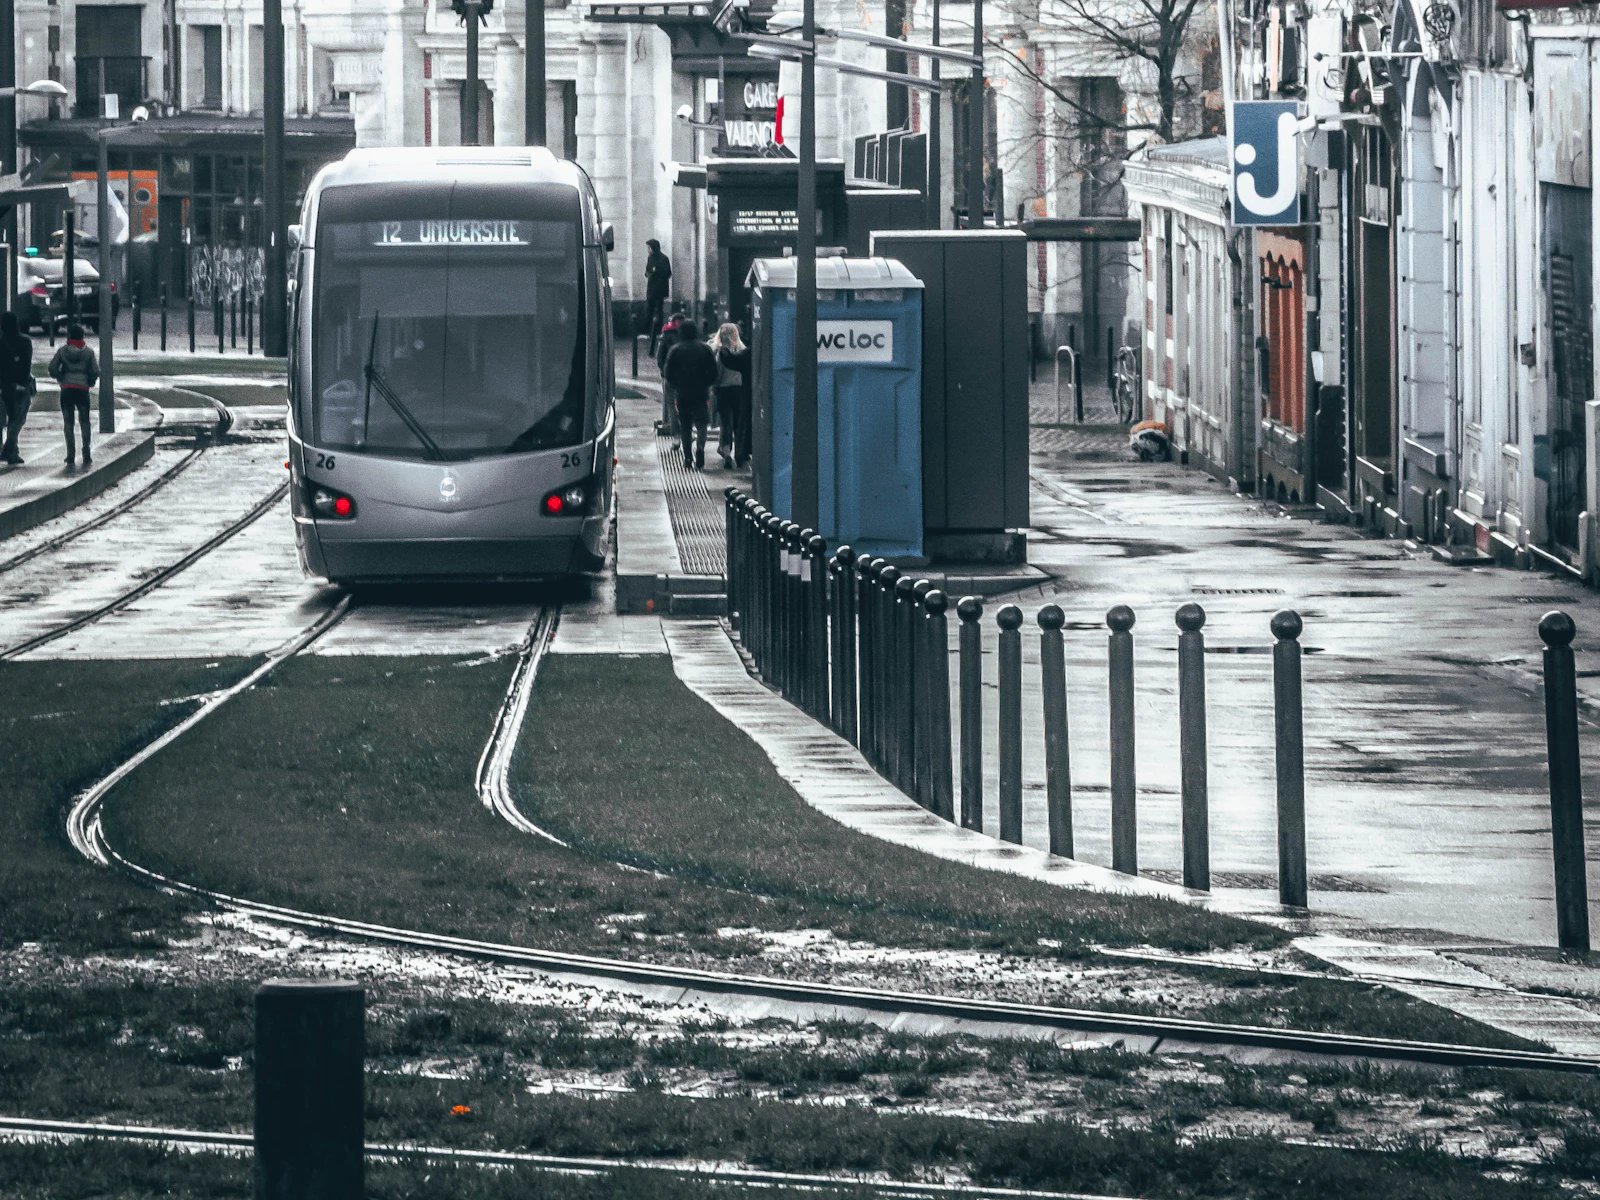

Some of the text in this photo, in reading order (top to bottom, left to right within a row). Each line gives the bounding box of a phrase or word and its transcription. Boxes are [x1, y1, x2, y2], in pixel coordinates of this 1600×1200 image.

[744, 82, 777, 108] GARE
[725, 120, 777, 148] VALENCI
[381, 221, 520, 242] T2 UNIVERSITE
[315, 453, 336, 471] 26
[560, 452, 581, 469] 26
